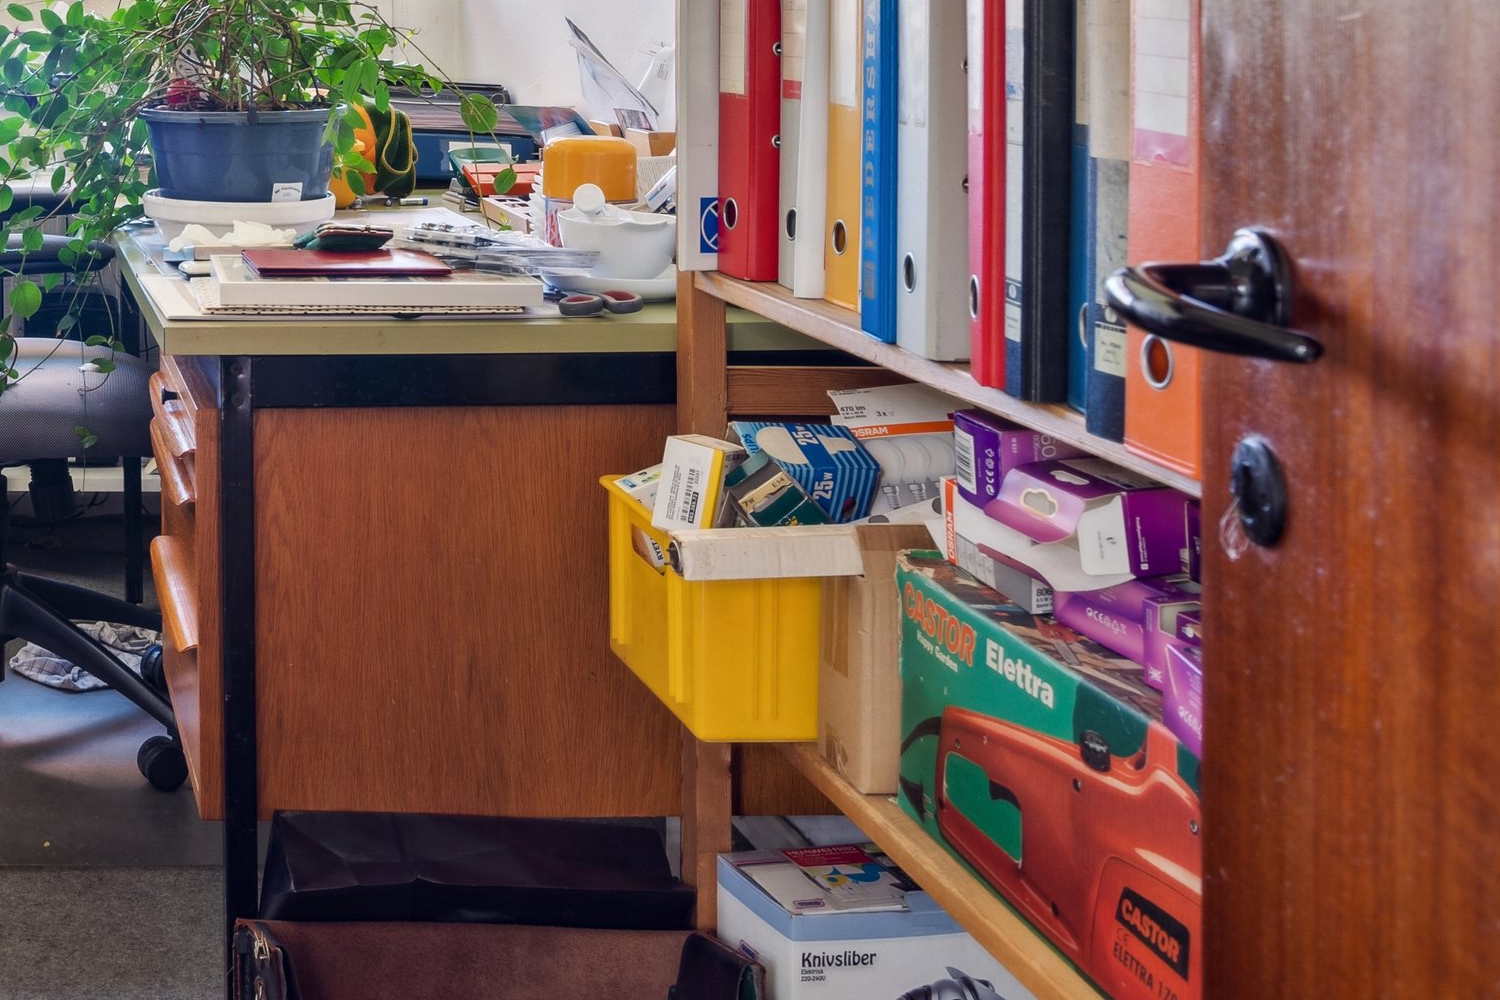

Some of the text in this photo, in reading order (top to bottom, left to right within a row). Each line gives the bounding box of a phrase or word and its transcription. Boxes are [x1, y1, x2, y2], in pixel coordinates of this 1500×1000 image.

[851, 426, 889, 438] OSRAM
[772, 477, 785, 488] E14
[742, 498, 755, 508] 7W
[947, 511, 955, 560] OSRAM
[651, 542, 663, 561] RYET
[904, 581, 1055, 709] CASTOR Elettra
[1121, 898, 1180, 964] CASTOR
[801, 951, 877, 968] Knivsliber
[1113, 941, 1153, 990] ELETTRA
